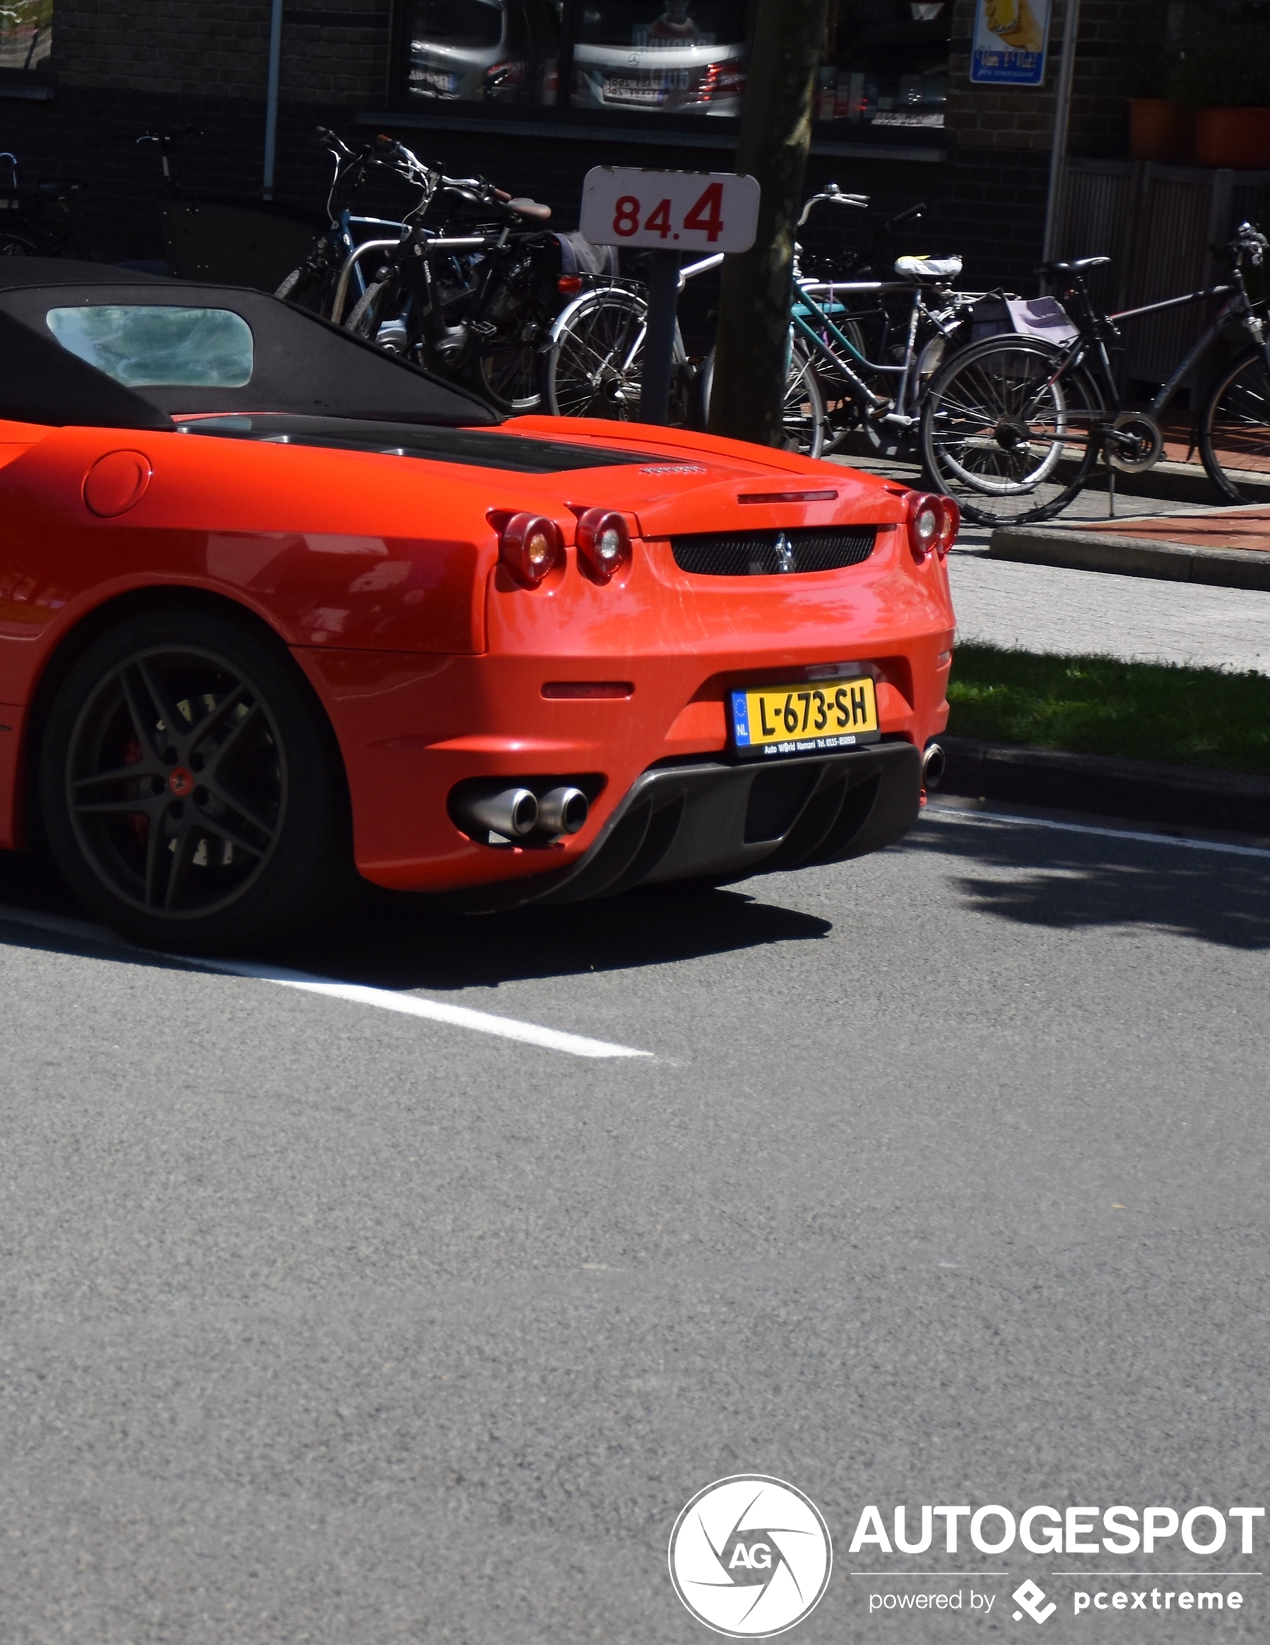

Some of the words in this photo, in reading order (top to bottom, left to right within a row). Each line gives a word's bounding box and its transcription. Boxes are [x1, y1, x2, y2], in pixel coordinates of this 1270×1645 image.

[612, 182, 724, 243] 84.4
[760, 687, 868, 736] L-673-SH
[737, 724, 748, 736] NL
[765, 745, 777, 754] Auto
